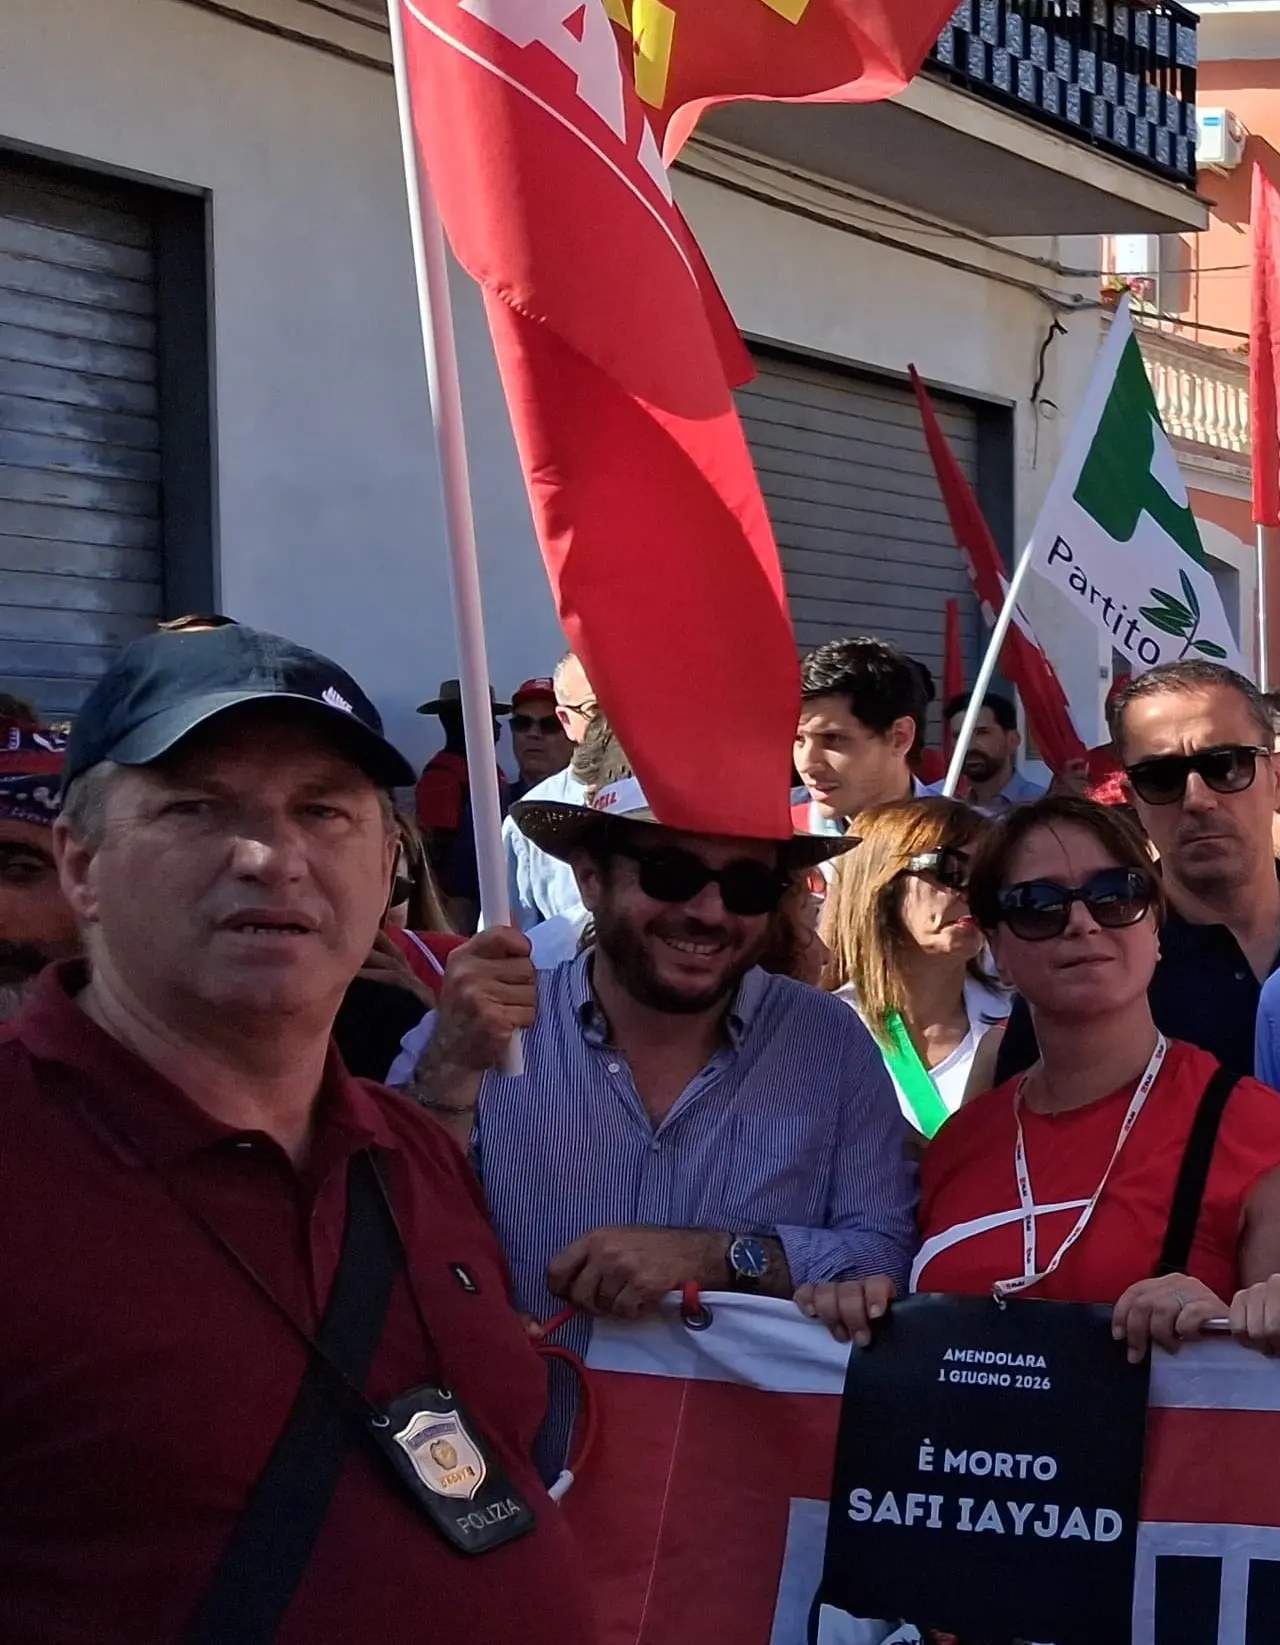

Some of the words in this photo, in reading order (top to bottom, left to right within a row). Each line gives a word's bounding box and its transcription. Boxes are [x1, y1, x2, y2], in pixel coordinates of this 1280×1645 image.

[1047, 535, 1161, 666] Partito
[942, 1348, 1047, 1369] AMENDOLARA
[938, 1368, 946, 1382] 1
[949, 1370, 1011, 1387] GIUGNO
[1015, 1375, 1051, 1390] 2026
[918, 1437, 935, 1472] È
[943, 1448, 1058, 1481] MORTO
[456, 1498, 521, 1534] POLIZIA
[848, 1487, 945, 1529] SAFI
[956, 1498, 1123, 1542] IAYJAD
